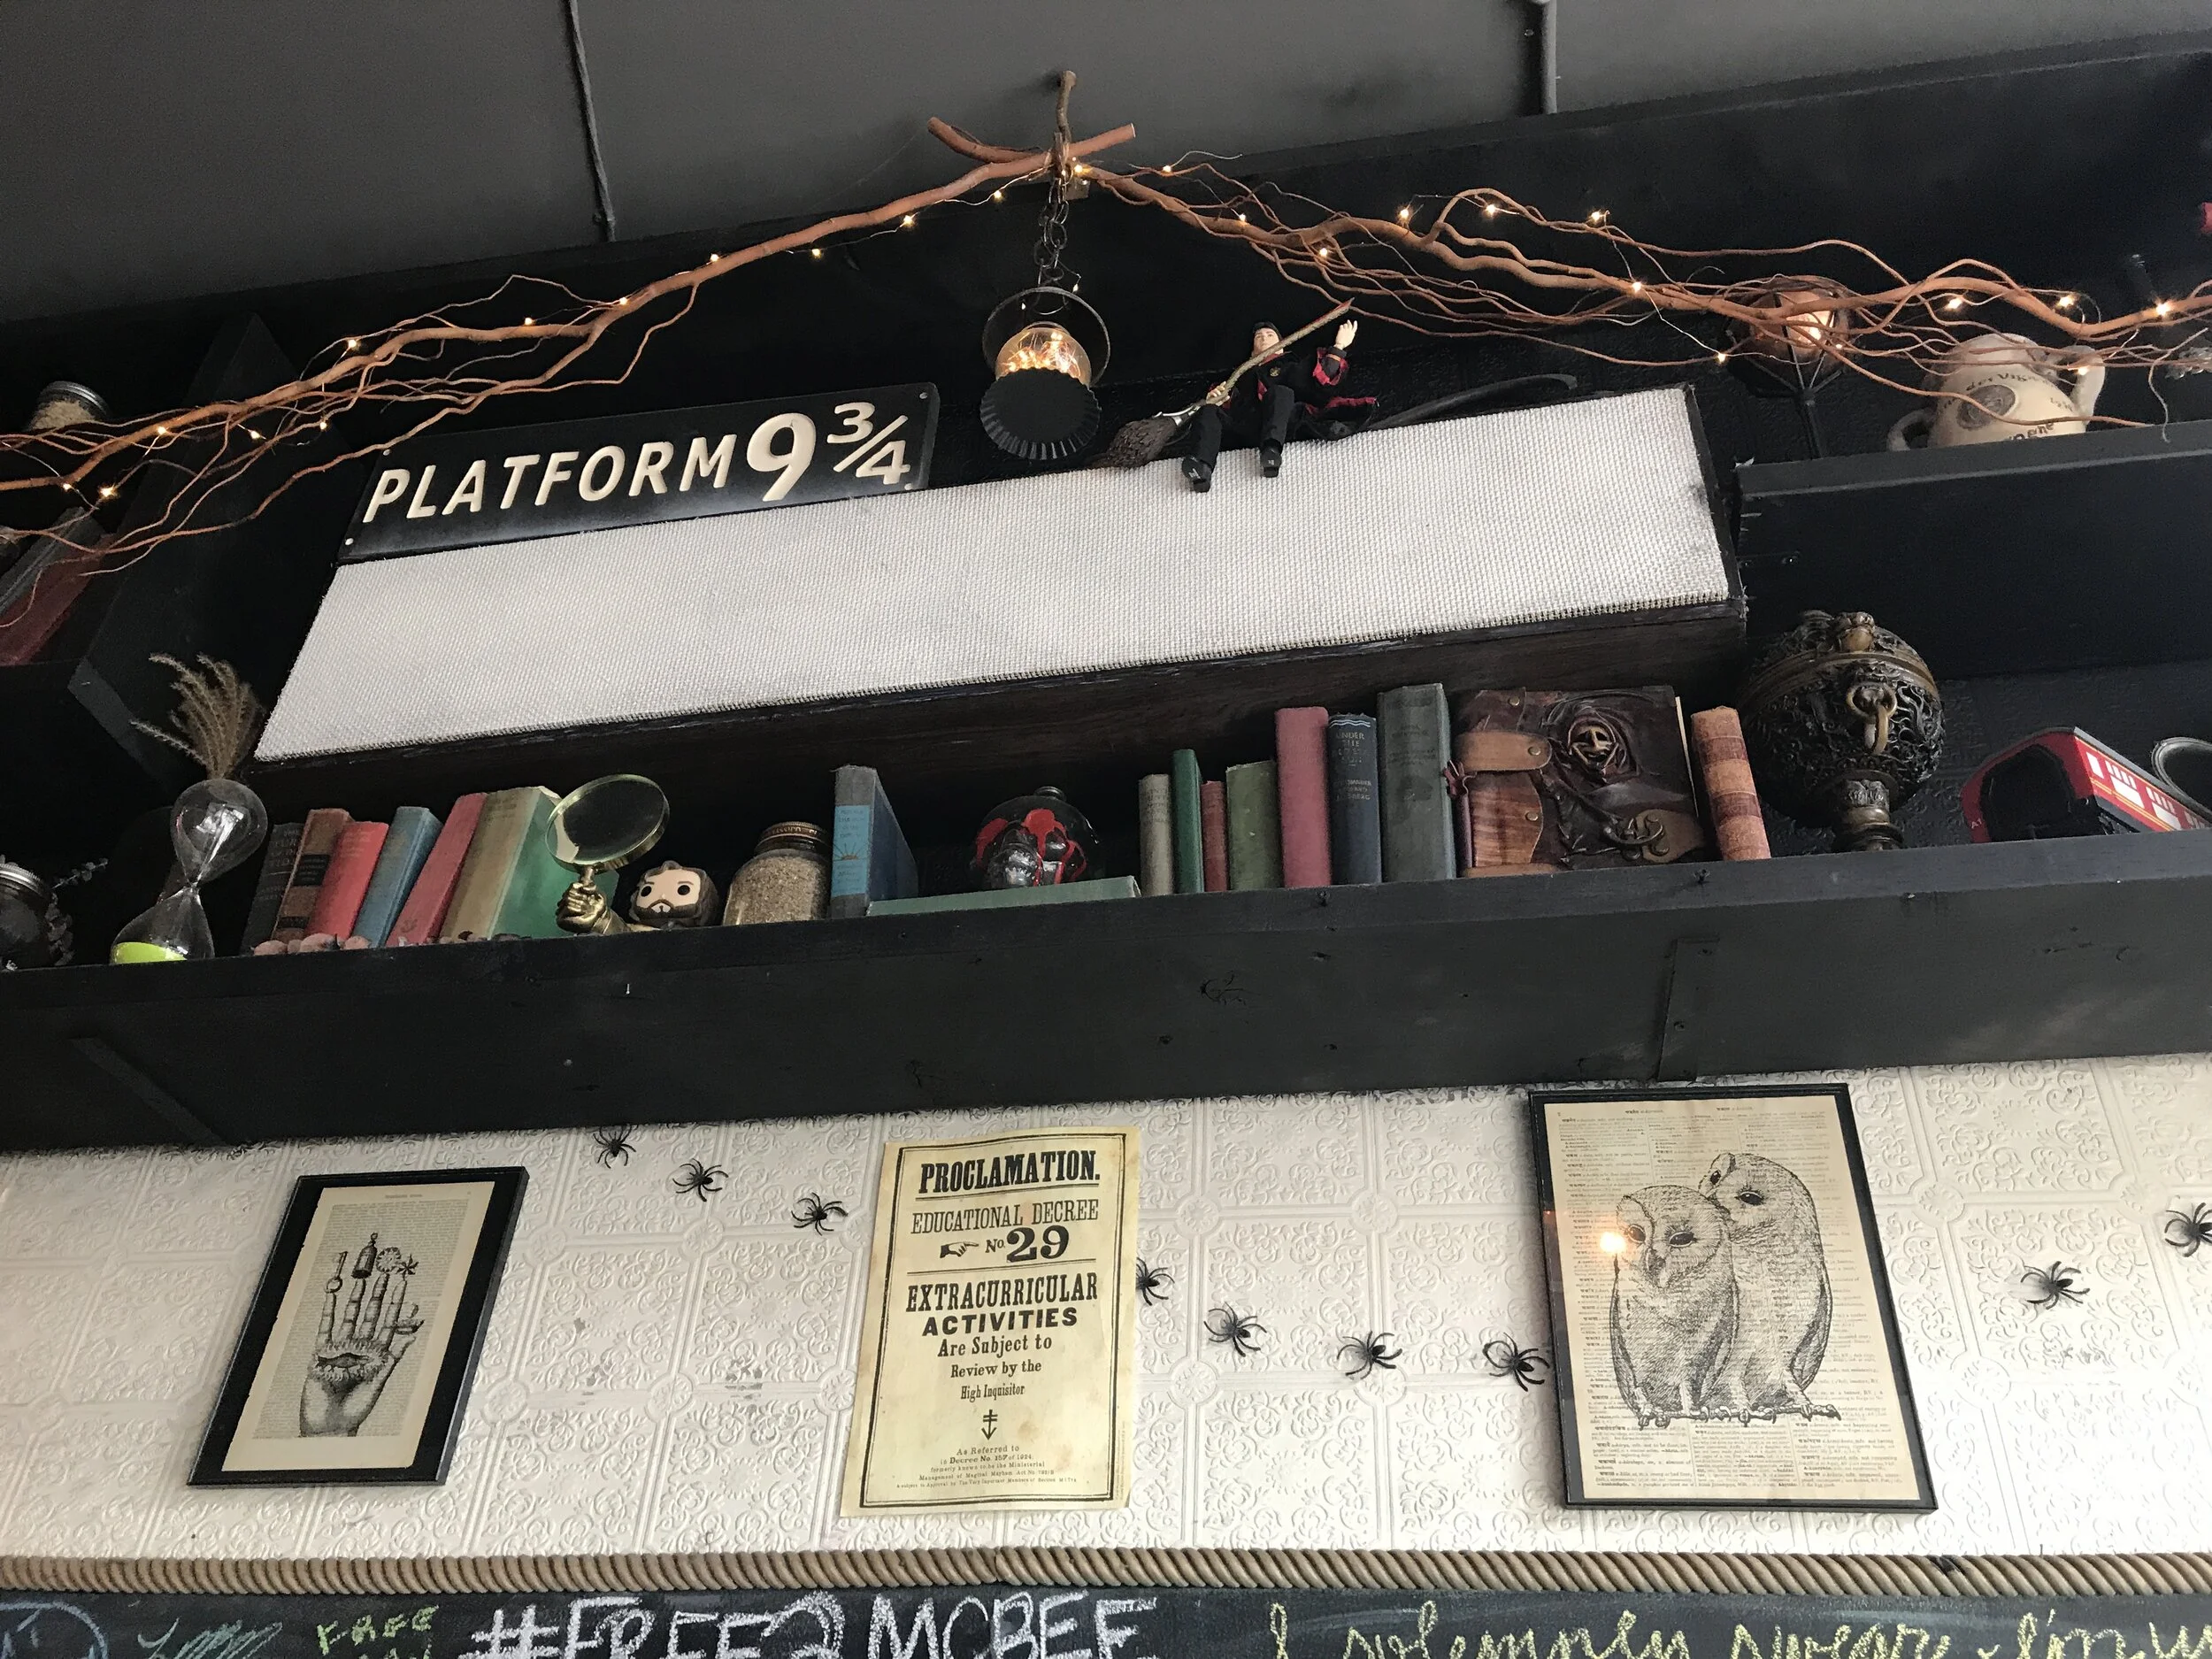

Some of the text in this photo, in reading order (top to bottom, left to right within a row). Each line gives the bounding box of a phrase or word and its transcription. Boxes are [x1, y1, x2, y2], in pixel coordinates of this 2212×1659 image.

[362, 434, 738, 524] PLATFORM
[918, 1149, 1101, 1194] PROCLAMATION.
[910, 1199, 1099, 1235] EDUCATIONAL DECREE
[985, 1225, 1070, 1263] No. 29
[905, 1271, 1098, 1313] EXTRACURRICULAR
[922, 1307, 1078, 1337] ACTIVITIES
[937, 1335, 1053, 1360] Are Subject to
[950, 1359, 1042, 1381] Review by the
[960, 1384, 1025, 1403] High Inquisitor
[956, 1448, 968, 1456] As
[971, 1445, 1009, 1455] Referred
[918, 1473, 954, 1482] Management
[930, 1465, 956, 1474] formerly
